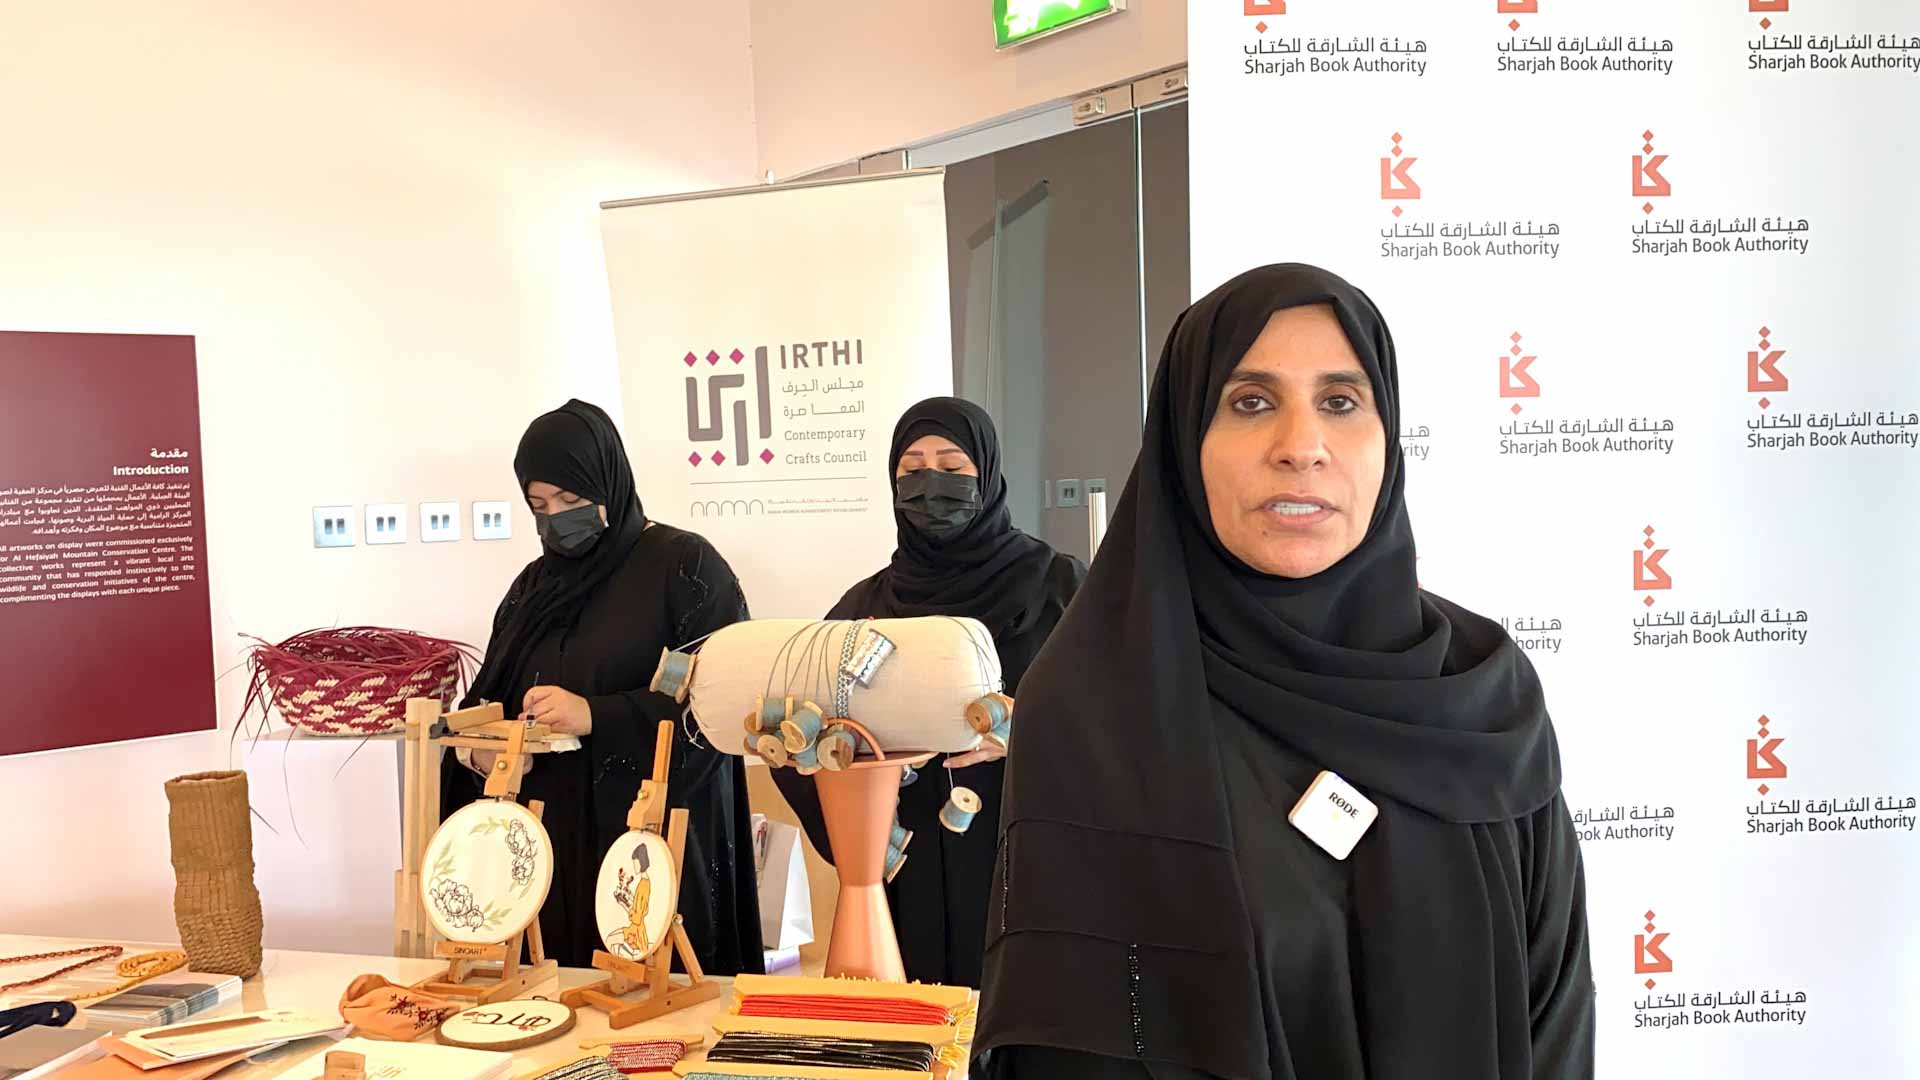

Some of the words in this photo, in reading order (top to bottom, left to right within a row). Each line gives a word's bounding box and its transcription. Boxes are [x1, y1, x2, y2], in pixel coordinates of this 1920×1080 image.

[1244, 38, 1300, 58] للكتاب
[1307, 37, 1374, 56] الشارقة
[1380, 37, 1427, 56] هيئة
[1497, 36, 1552, 55] للكتاب
[1557, 36, 1621, 55] الشارقة
[1627, 37, 1673, 55] هيئة
[1748, 34, 1802, 53] للكتاب
[1807, 34, 1871, 53] الشارقة
[1244, 57, 1304, 77] Sharjah
[1310, 57, 1350, 72] Book
[1353, 57, 1427, 77] Authority
[1497, 56, 1555, 74] Sharjah
[1560, 56, 1598, 71] Book
[1601, 56, 1673, 75] Authority
[1748, 54, 1805, 72] Sharjah
[1810, 54, 1848, 69] Book
[1850, 53, 1920, 72] Authority
[1380, 222, 1434, 241] للكتاب
[1440, 221, 1506, 240] الشارقة
[1512, 221, 1560, 239] هيئة
[1632, 219, 1684, 238] للكتاب
[1690, 217, 1755, 237] الشارقة
[1762, 216, 1809, 235] هيئة
[1381, 241, 1438, 260] Sharjah
[1443, 241, 1481, 257] Book
[1484, 240, 1560, 259] Authority
[1632, 238, 1687, 256] Sharjah
[1692, 237, 1731, 253] Book
[1734, 236, 1809, 255] Authority
[780, 339, 863, 369] IRTHI
[822, 377, 864, 394] مجلس
[1500, 420, 1554, 439] للكتاب
[1559, 418, 1623, 437] الشارقة
[1629, 417, 1674, 435] هيئة
[1747, 413, 1801, 432] للكتاب
[1807, 412, 1871, 431] الشارقة
[1876, 411, 1919, 429] هيئة
[784, 427, 866, 442] Contemporary
[1747, 432, 1805, 450] Sharjah
[1810, 431, 1847, 447] Book
[1850, 430, 1919, 448] Authority
[150, 447, 189, 459] مقدمة
[1500, 438, 1557, 456] Sharjah
[1562, 437, 1599, 453] Book
[1603, 436, 1674, 454] Authority
[785, 452, 821, 465] Crafts
[823, 450, 867, 464] Council
[113, 464, 189, 476] Introduction
[9, 543, 43, 552] artworks
[57, 541, 83, 550] display
[105, 537, 155, 547] commissioned
[156, 535, 193, 544] exclusively
[25, 552, 59, 561] Hefaiyah
[62, 550, 98, 559] Mountain
[102, 547, 149, 557] Conservation
[0, 565, 34, 573] collective
[41, 562, 64, 570] works
[71, 560, 106, 569] represent
[125, 557, 151, 565] vibrant
[157, 555, 174, 563] local
[0, 574, 42, 583] community
[46, 572, 62, 580] that
[66, 571, 80, 579] has
[84, 568, 121, 577] responded
[126, 565, 167, 574] instinctively
[0, 585, 27, 593] wildlife
[51, 580, 99, 590] conservation
[103, 577, 138, 586] initiatives
[142, 576, 150, 584] of
[0, 593, 56, 604] complimenting
[71, 590, 100, 599] displays
[101, 588, 117, 596] with
[118, 587, 135, 595] each
[136, 584, 160, 593] unique
[1515, 617, 1562, 634] هيئة
[1633, 611, 1685, 630] للكتاب
[1690, 609, 1755, 628] الشارقة
[1760, 608, 1808, 626] هيئة
[1515, 636, 1562, 653] hority
[1633, 629, 1688, 647] Sharjah
[1693, 628, 1730, 644] Book
[1734, 627, 1808, 645] Authority
[1630, 805, 1674, 822] هيئة
[1746, 799, 1800, 818] للكتاب
[1806, 797, 1869, 816] الشارقة
[1874, 796, 1917, 813] هيئة
[1573, 806, 1624, 826] الشارق
[1747, 818, 1803, 836] Sharjah
[1808, 816, 1846, 832] Book
[1849, 814, 1917, 831] Authority
[1576, 826, 1601, 841] ook
[1604, 824, 1673, 841] Authority
[1634, 993, 1685, 1013] للكتاب
[1691, 991, 1755, 1009] الشارقة
[1760, 990, 1807, 1007] هيئة
[1634, 1011, 1689, 1030] Sharjah
[1694, 1009, 1730, 1025] Book
[1734, 1008, 1807, 1026] Authority
